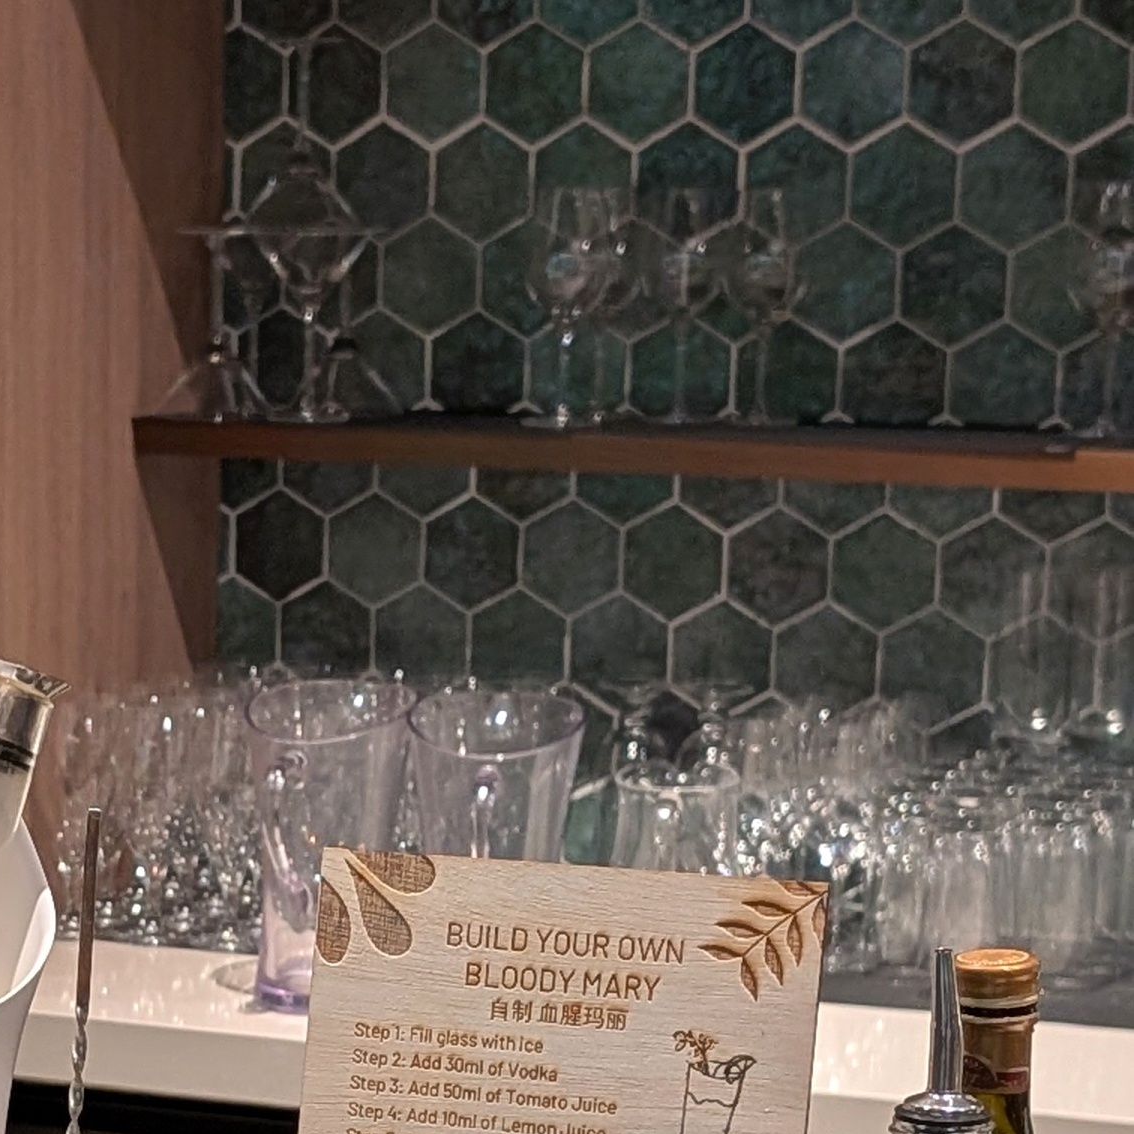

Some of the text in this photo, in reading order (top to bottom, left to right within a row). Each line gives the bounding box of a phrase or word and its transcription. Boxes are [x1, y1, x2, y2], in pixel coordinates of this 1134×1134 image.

[446, 921, 685, 964] BUILD YOUR OWN
[465, 962, 661, 1001] BLOODY MARY
[354, 1022, 390, 1041] Step
[395, 1025, 405, 1041] 1:
[409, 1026, 433, 1044] Fill
[436, 1029, 478, 1048] glass
[481, 1034, 515, 1051] with
[352, 1048, 558, 1083] Step 2: Add 30ml of Vodka
[349, 1075, 618, 1115] Step 3: Add 50ml of Tomato Juice
[347, 1102, 383, 1121] Step
[387, 1105, 401, 1121] 4:
[406, 1108, 437, 1125] Add
[442, 1111, 477, 1128] 10ml
[481, 1115, 497, 1131] of
